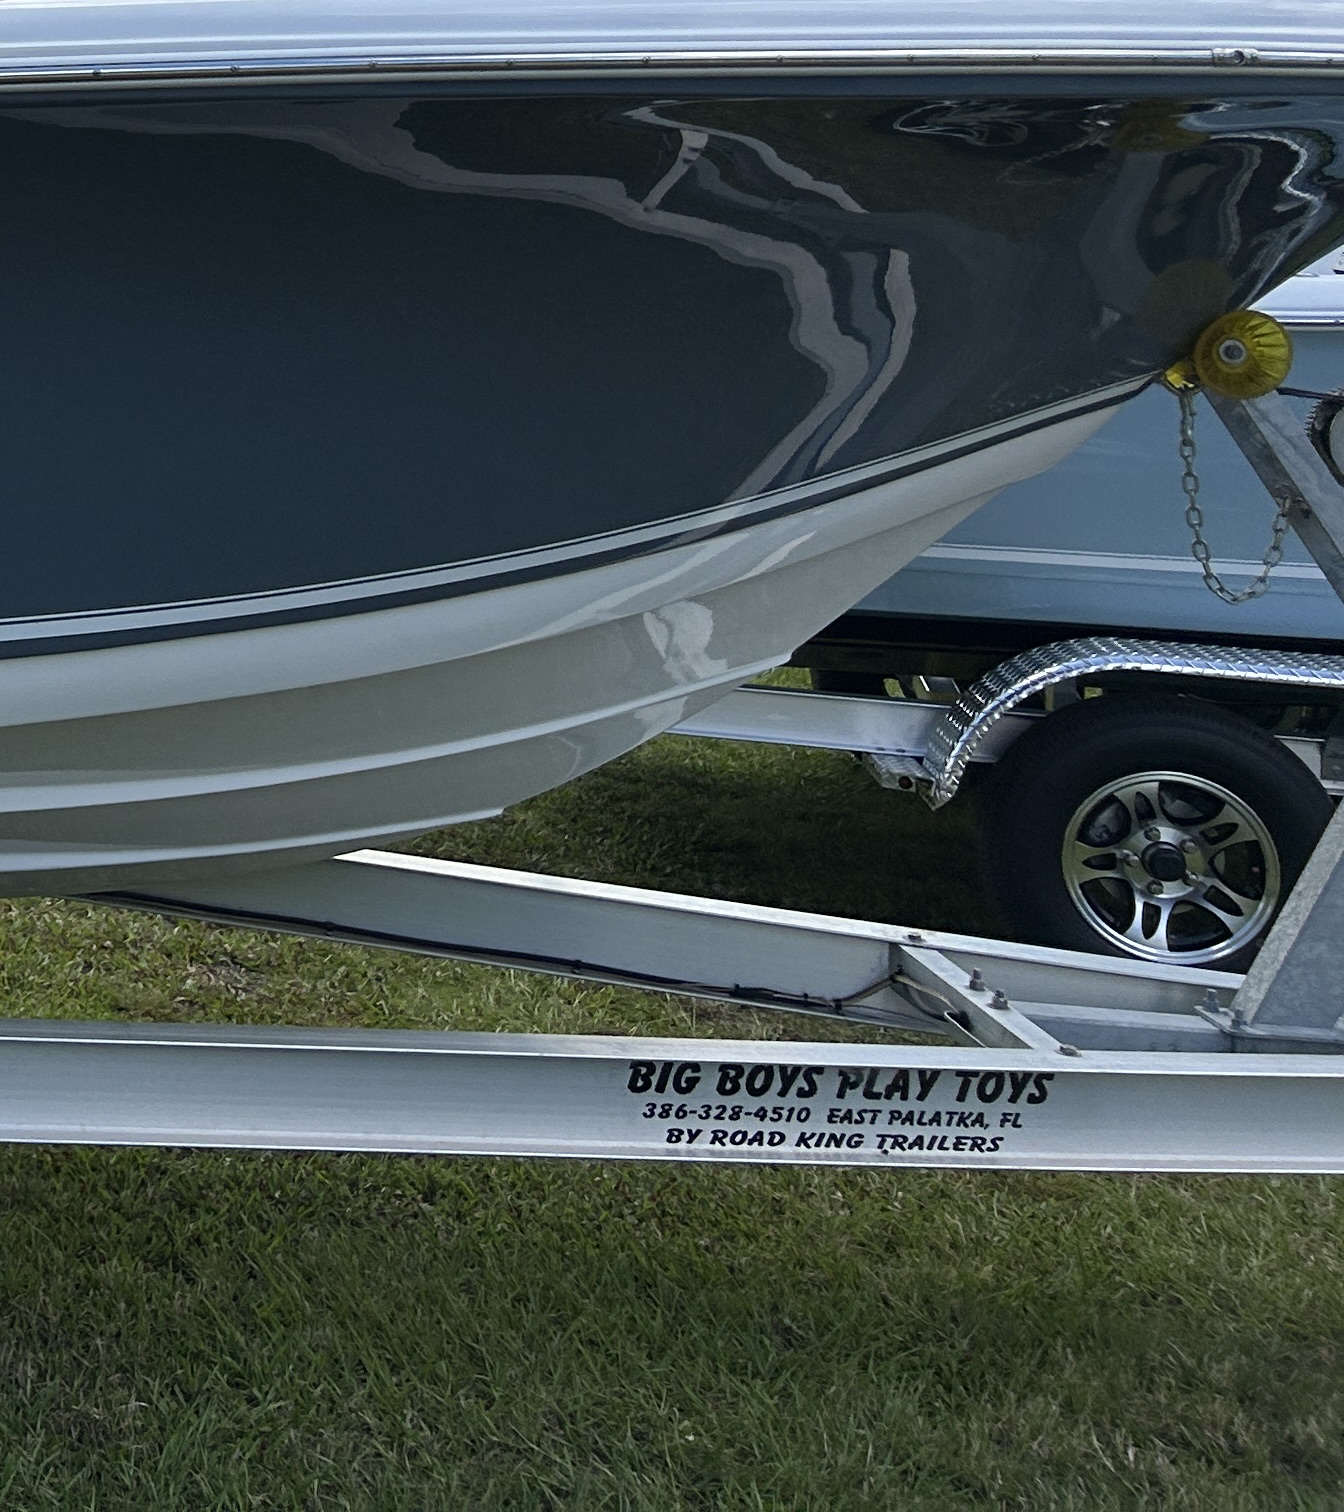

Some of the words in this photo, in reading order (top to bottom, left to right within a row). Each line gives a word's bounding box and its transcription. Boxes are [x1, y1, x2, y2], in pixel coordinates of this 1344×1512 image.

[627, 1061, 702, 1095] BIG
[716, 1064, 824, 1099] BOYS
[836, 1068, 942, 1102] PLAY
[955, 1071, 1055, 1105] TOYS
[642, 1102, 811, 1123] 386-328-4510
[827, 1108, 883, 1125] EAST
[888, 1110, 990, 1130] PALATKA,
[999, 1112, 1023, 1128] FL
[666, 1127, 704, 1144] BY
[710, 1129, 787, 1147] ROAD
[795, 1131, 865, 1149] KING
[876, 1133, 1005, 1153] TRAILERS
